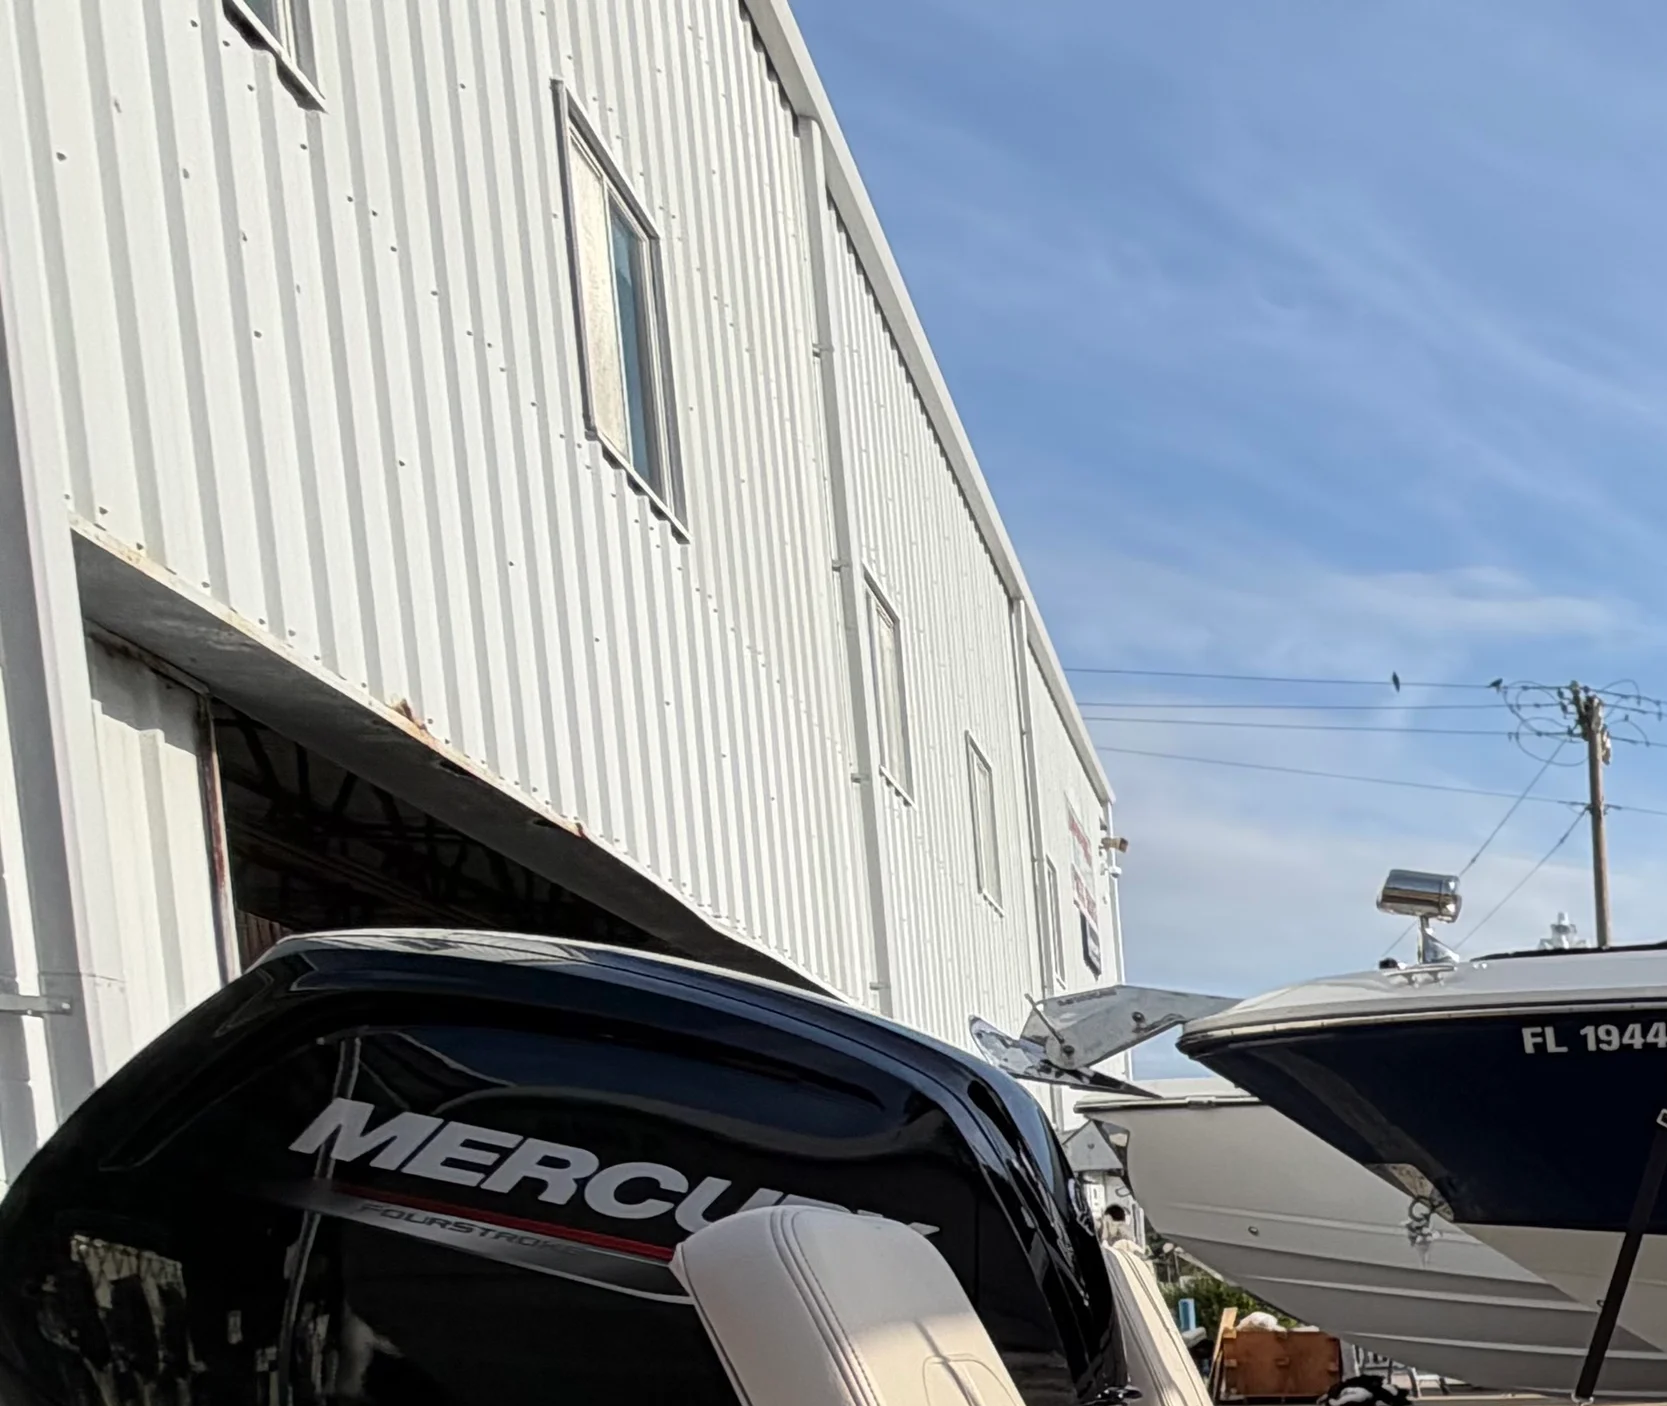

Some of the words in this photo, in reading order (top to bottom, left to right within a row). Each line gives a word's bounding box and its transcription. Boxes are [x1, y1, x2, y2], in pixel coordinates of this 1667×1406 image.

[1522, 1026, 1568, 1054] FL
[288, 1097, 941, 1236] MERCU
[350, 1202, 582, 1256] FOURSTROKE
